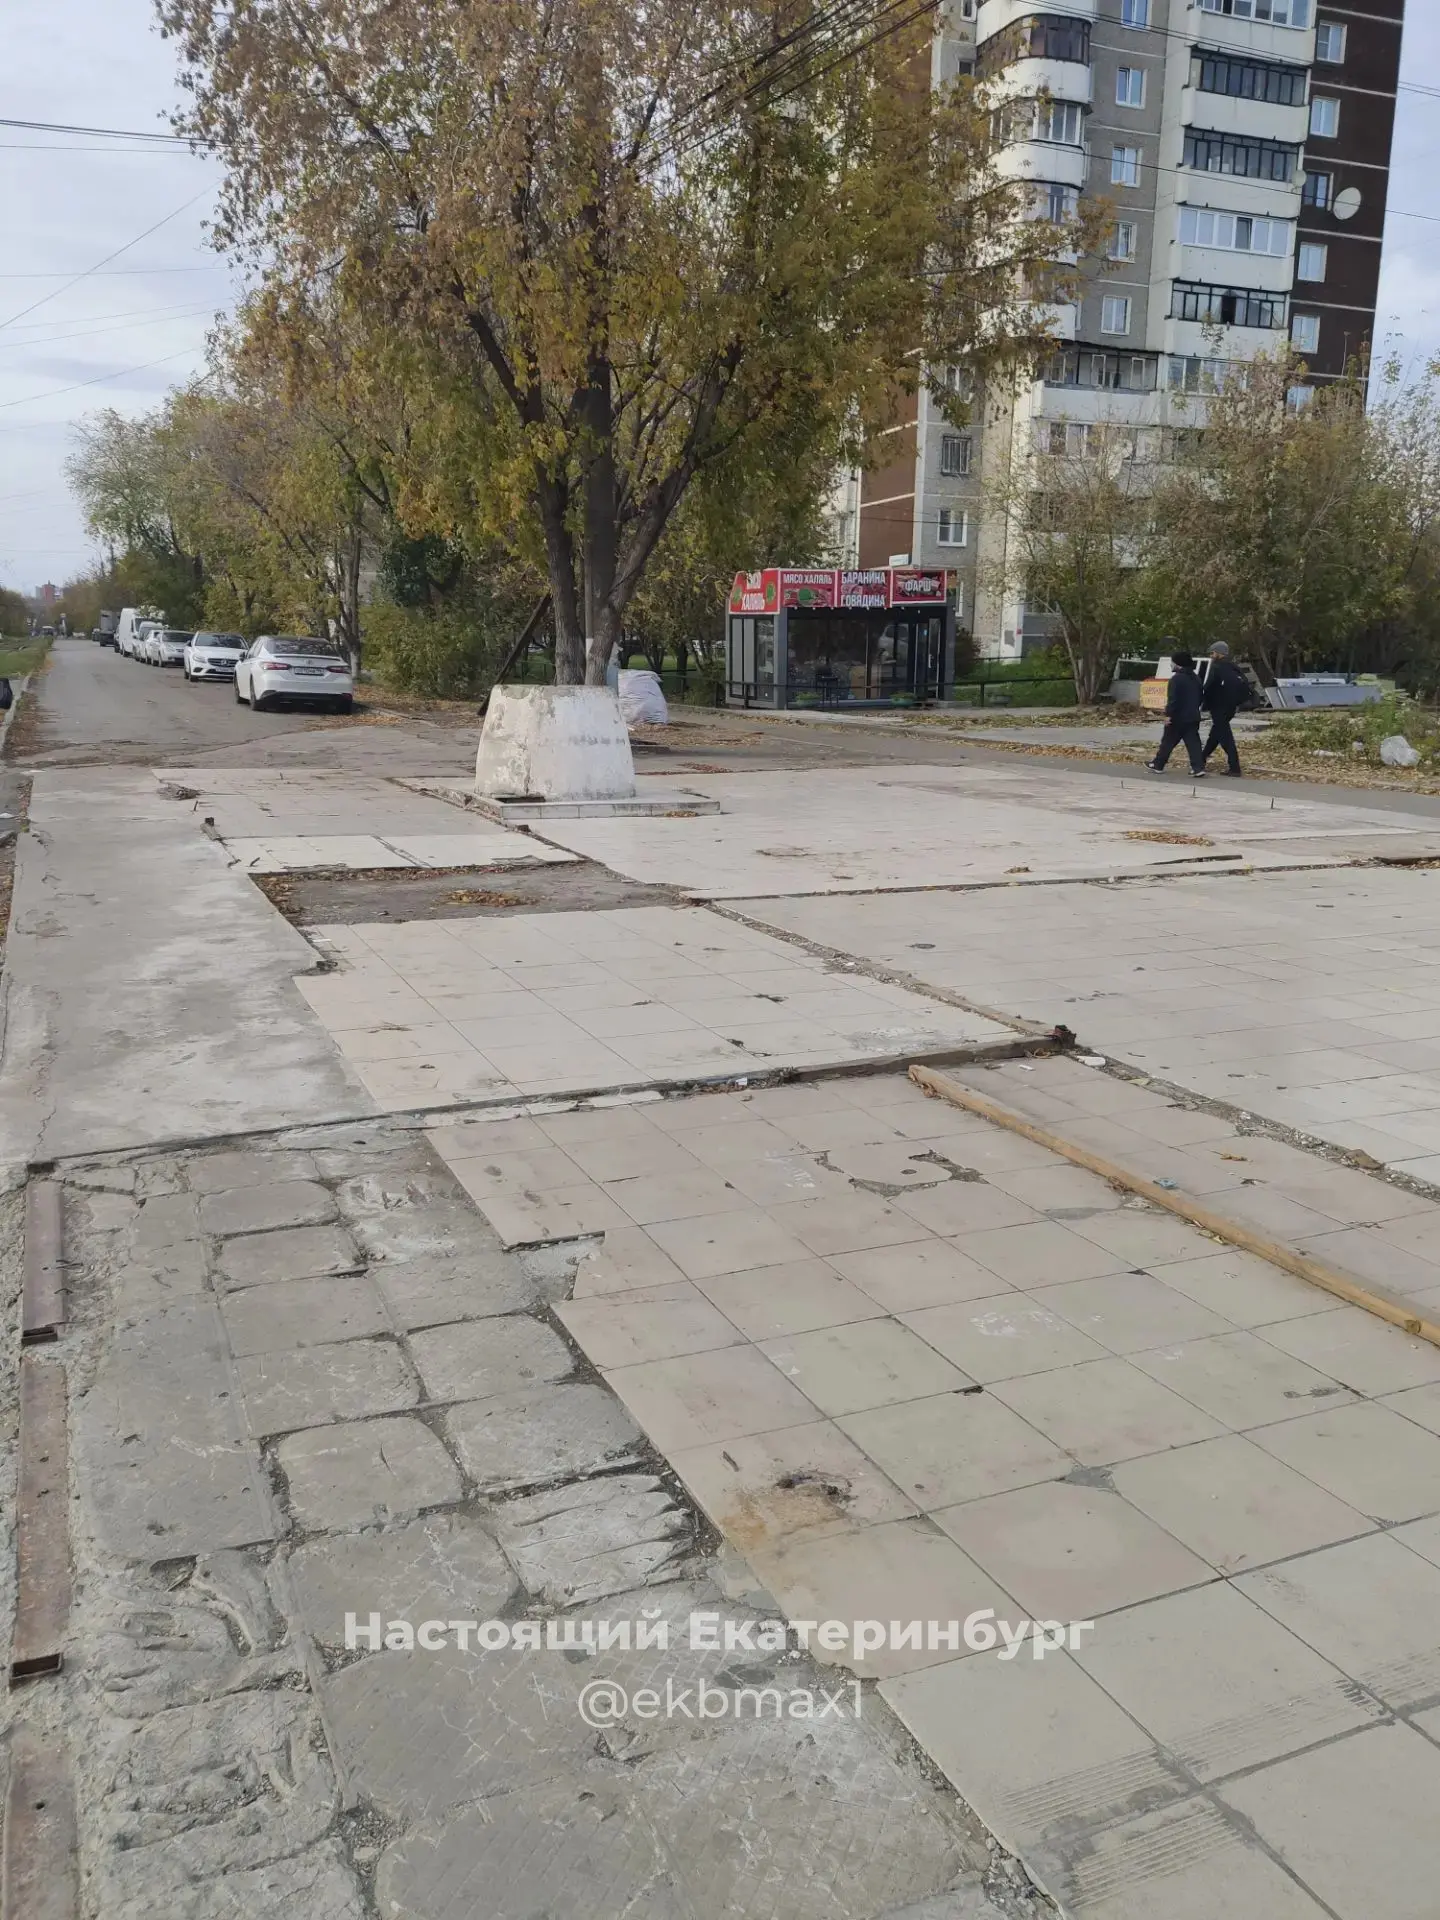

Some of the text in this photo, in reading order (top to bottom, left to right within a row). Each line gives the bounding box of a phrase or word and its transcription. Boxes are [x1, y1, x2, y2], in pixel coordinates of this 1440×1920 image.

[783, 573, 833, 584] МЯСО ХАЛЯЛЬ
[841, 571, 886, 584] БАРАНИНА
[904, 579, 932, 592] ФАРШ
[840, 594, 885, 608] ГОВЯДИНА
